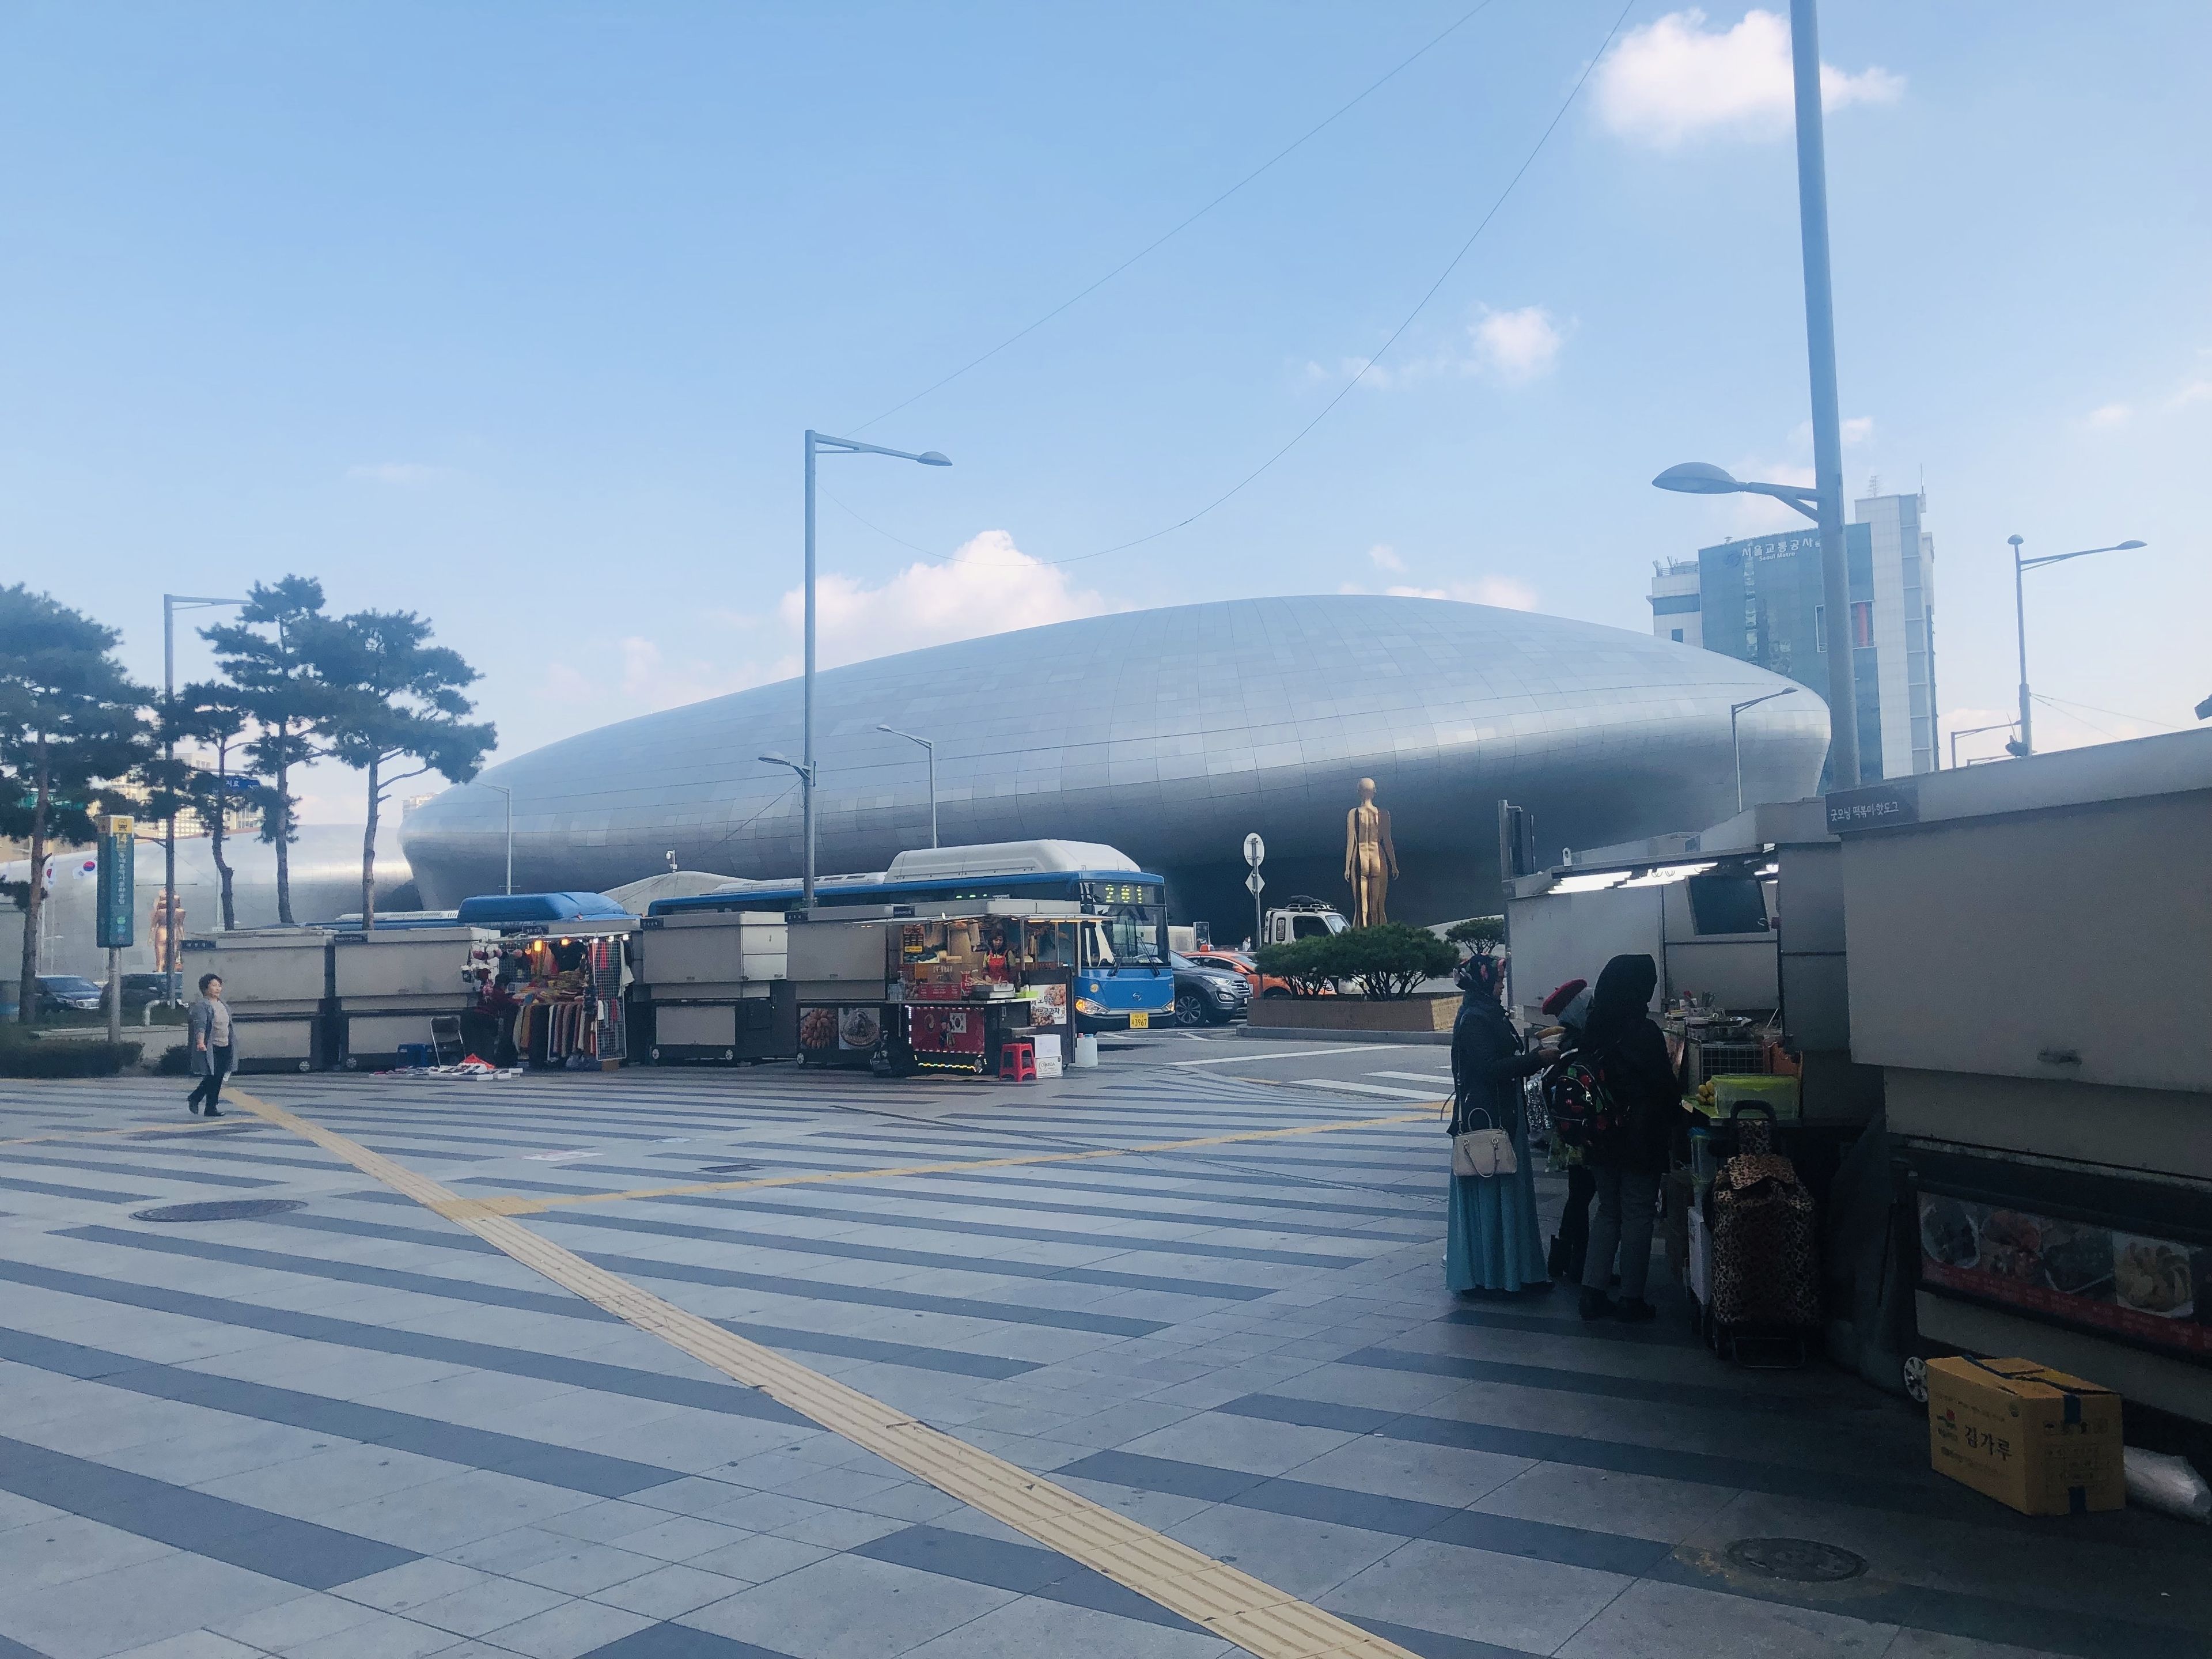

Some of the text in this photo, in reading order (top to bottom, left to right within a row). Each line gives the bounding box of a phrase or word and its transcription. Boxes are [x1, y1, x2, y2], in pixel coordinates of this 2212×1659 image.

[1741, 537, 1813, 557] 서울교통공사
[1759, 554, 1775, 562] Seoul
[1831, 801, 1899, 821] 굿모닝 떡볶이 핫도그
[116, 834, 127, 844] 14
[1965, 1425, 2012, 1461] 김가루
